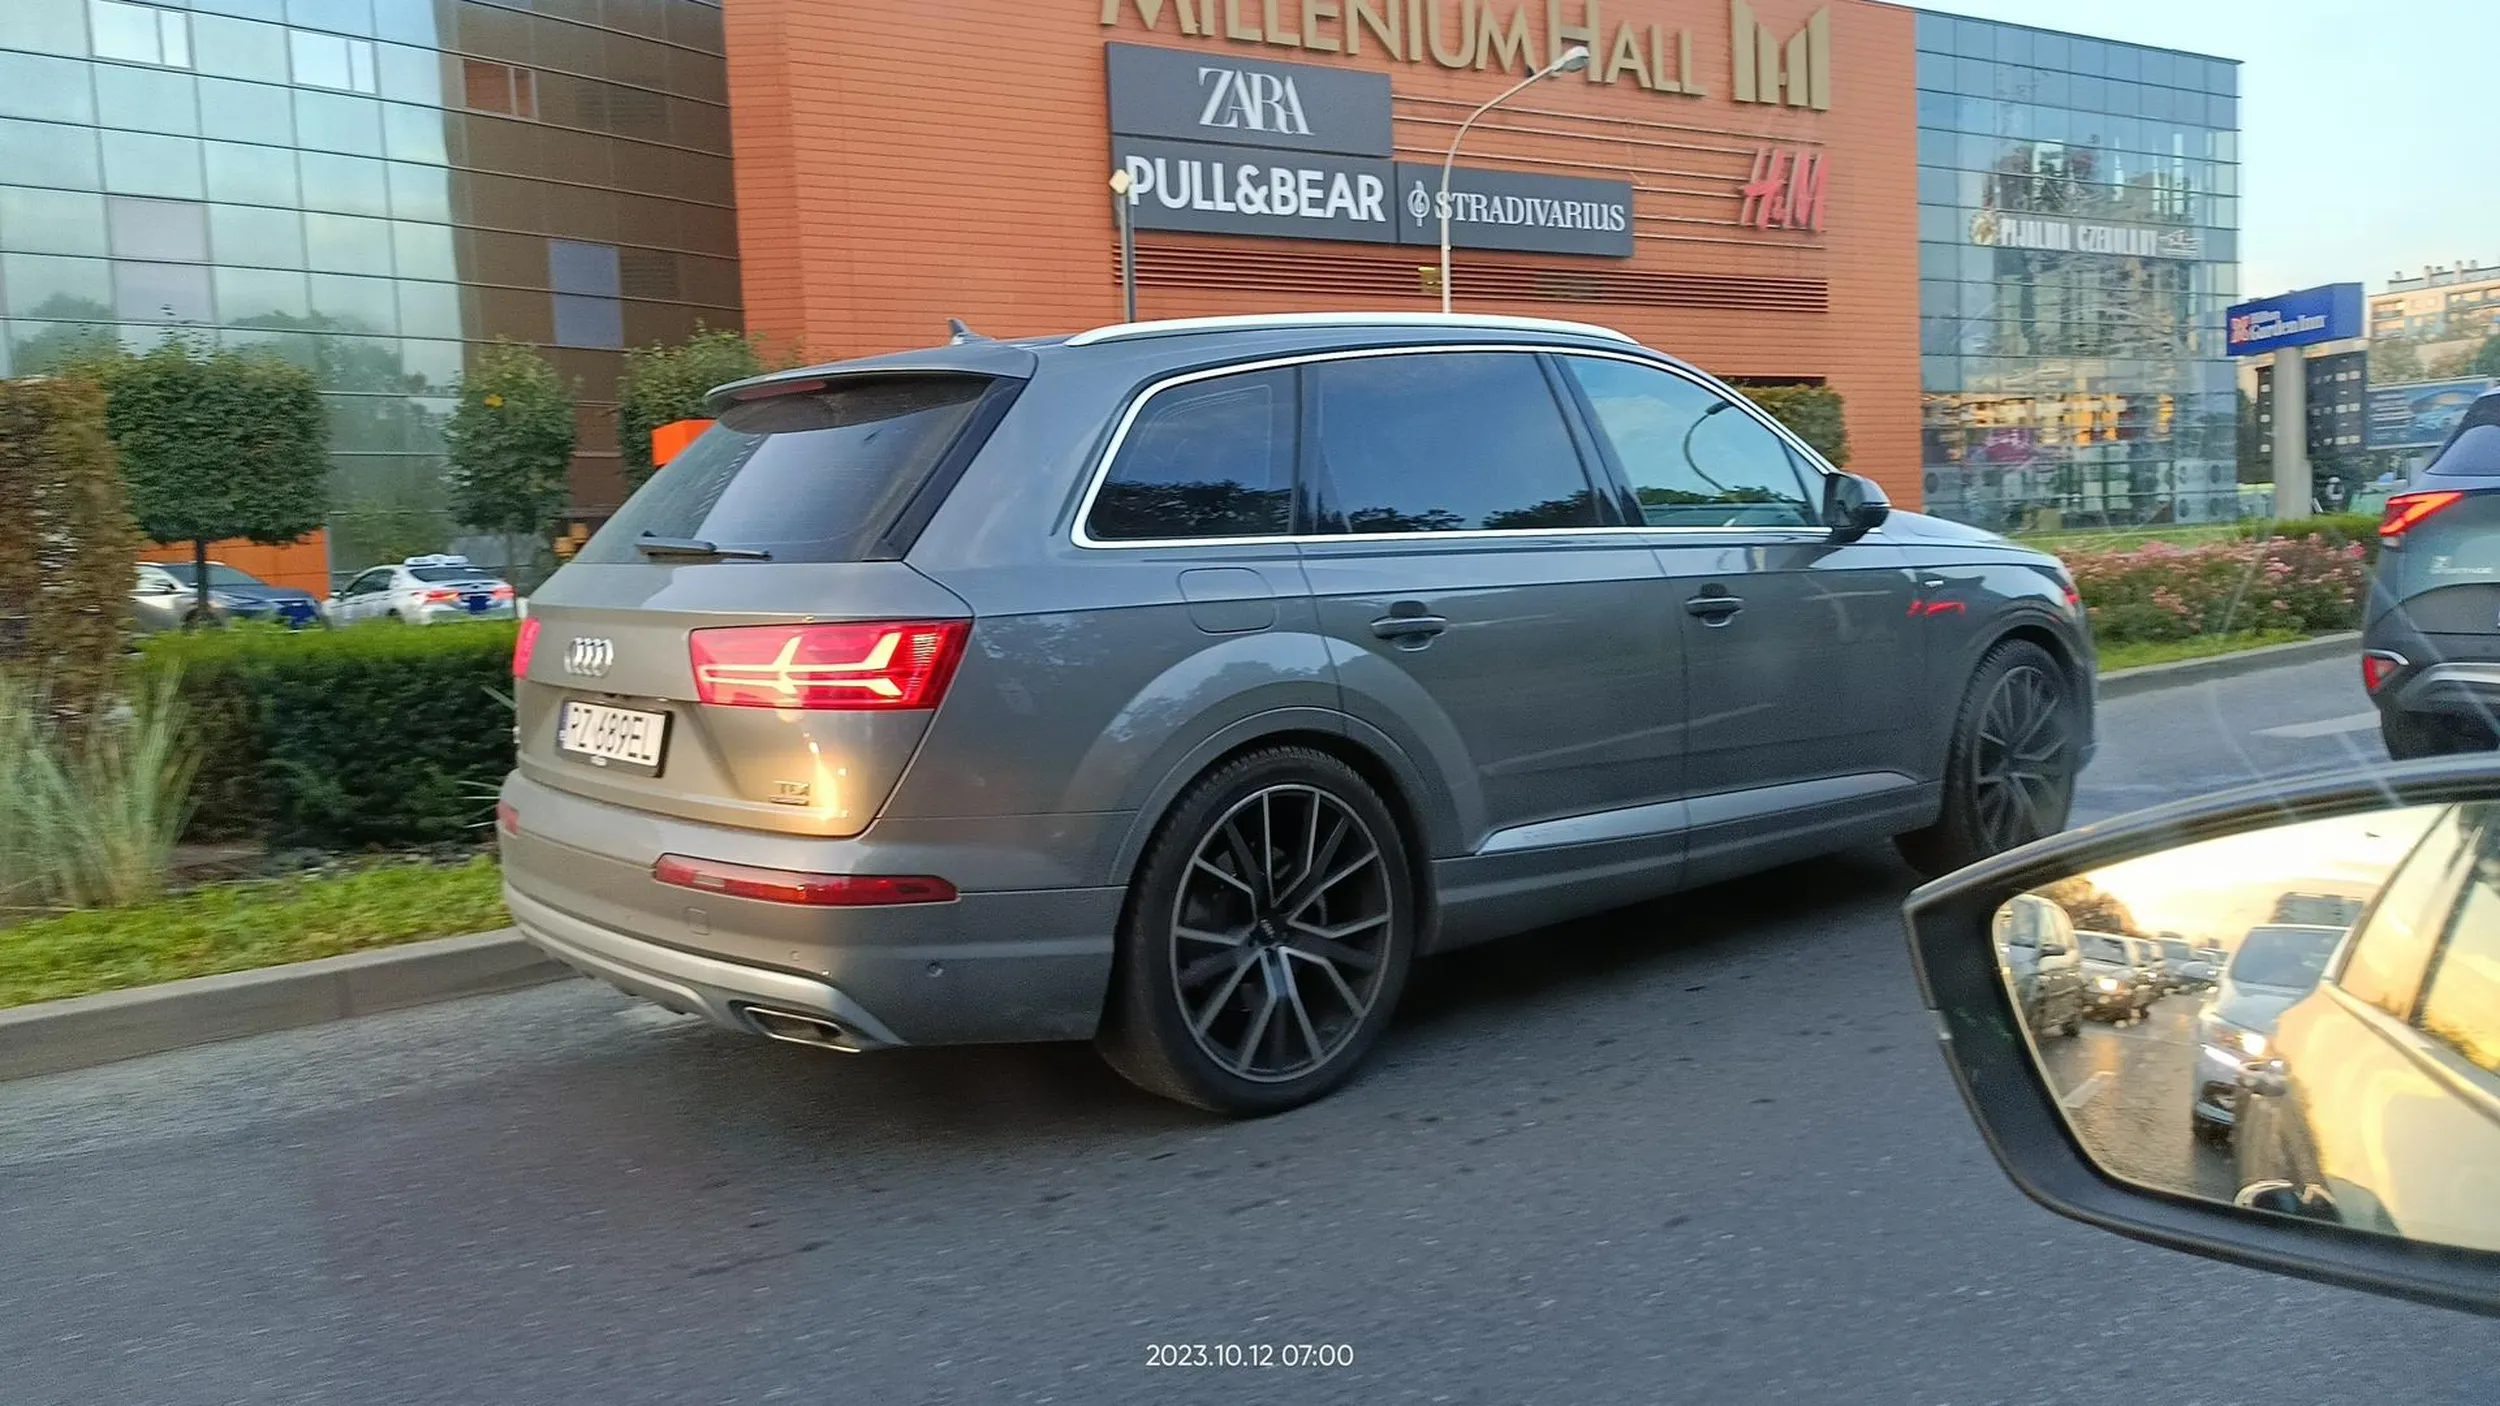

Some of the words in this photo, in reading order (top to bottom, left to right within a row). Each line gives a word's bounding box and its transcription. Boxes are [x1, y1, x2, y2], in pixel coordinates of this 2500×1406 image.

[1548, 0, 1706, 96] HALL
[1198, 66, 1317, 136] ZARA
[1125, 155, 1387, 222] PULL&BEAR
[1434, 190, 1626, 231] STRADIVARIUS
[1739, 147, 1831, 232] H&M
